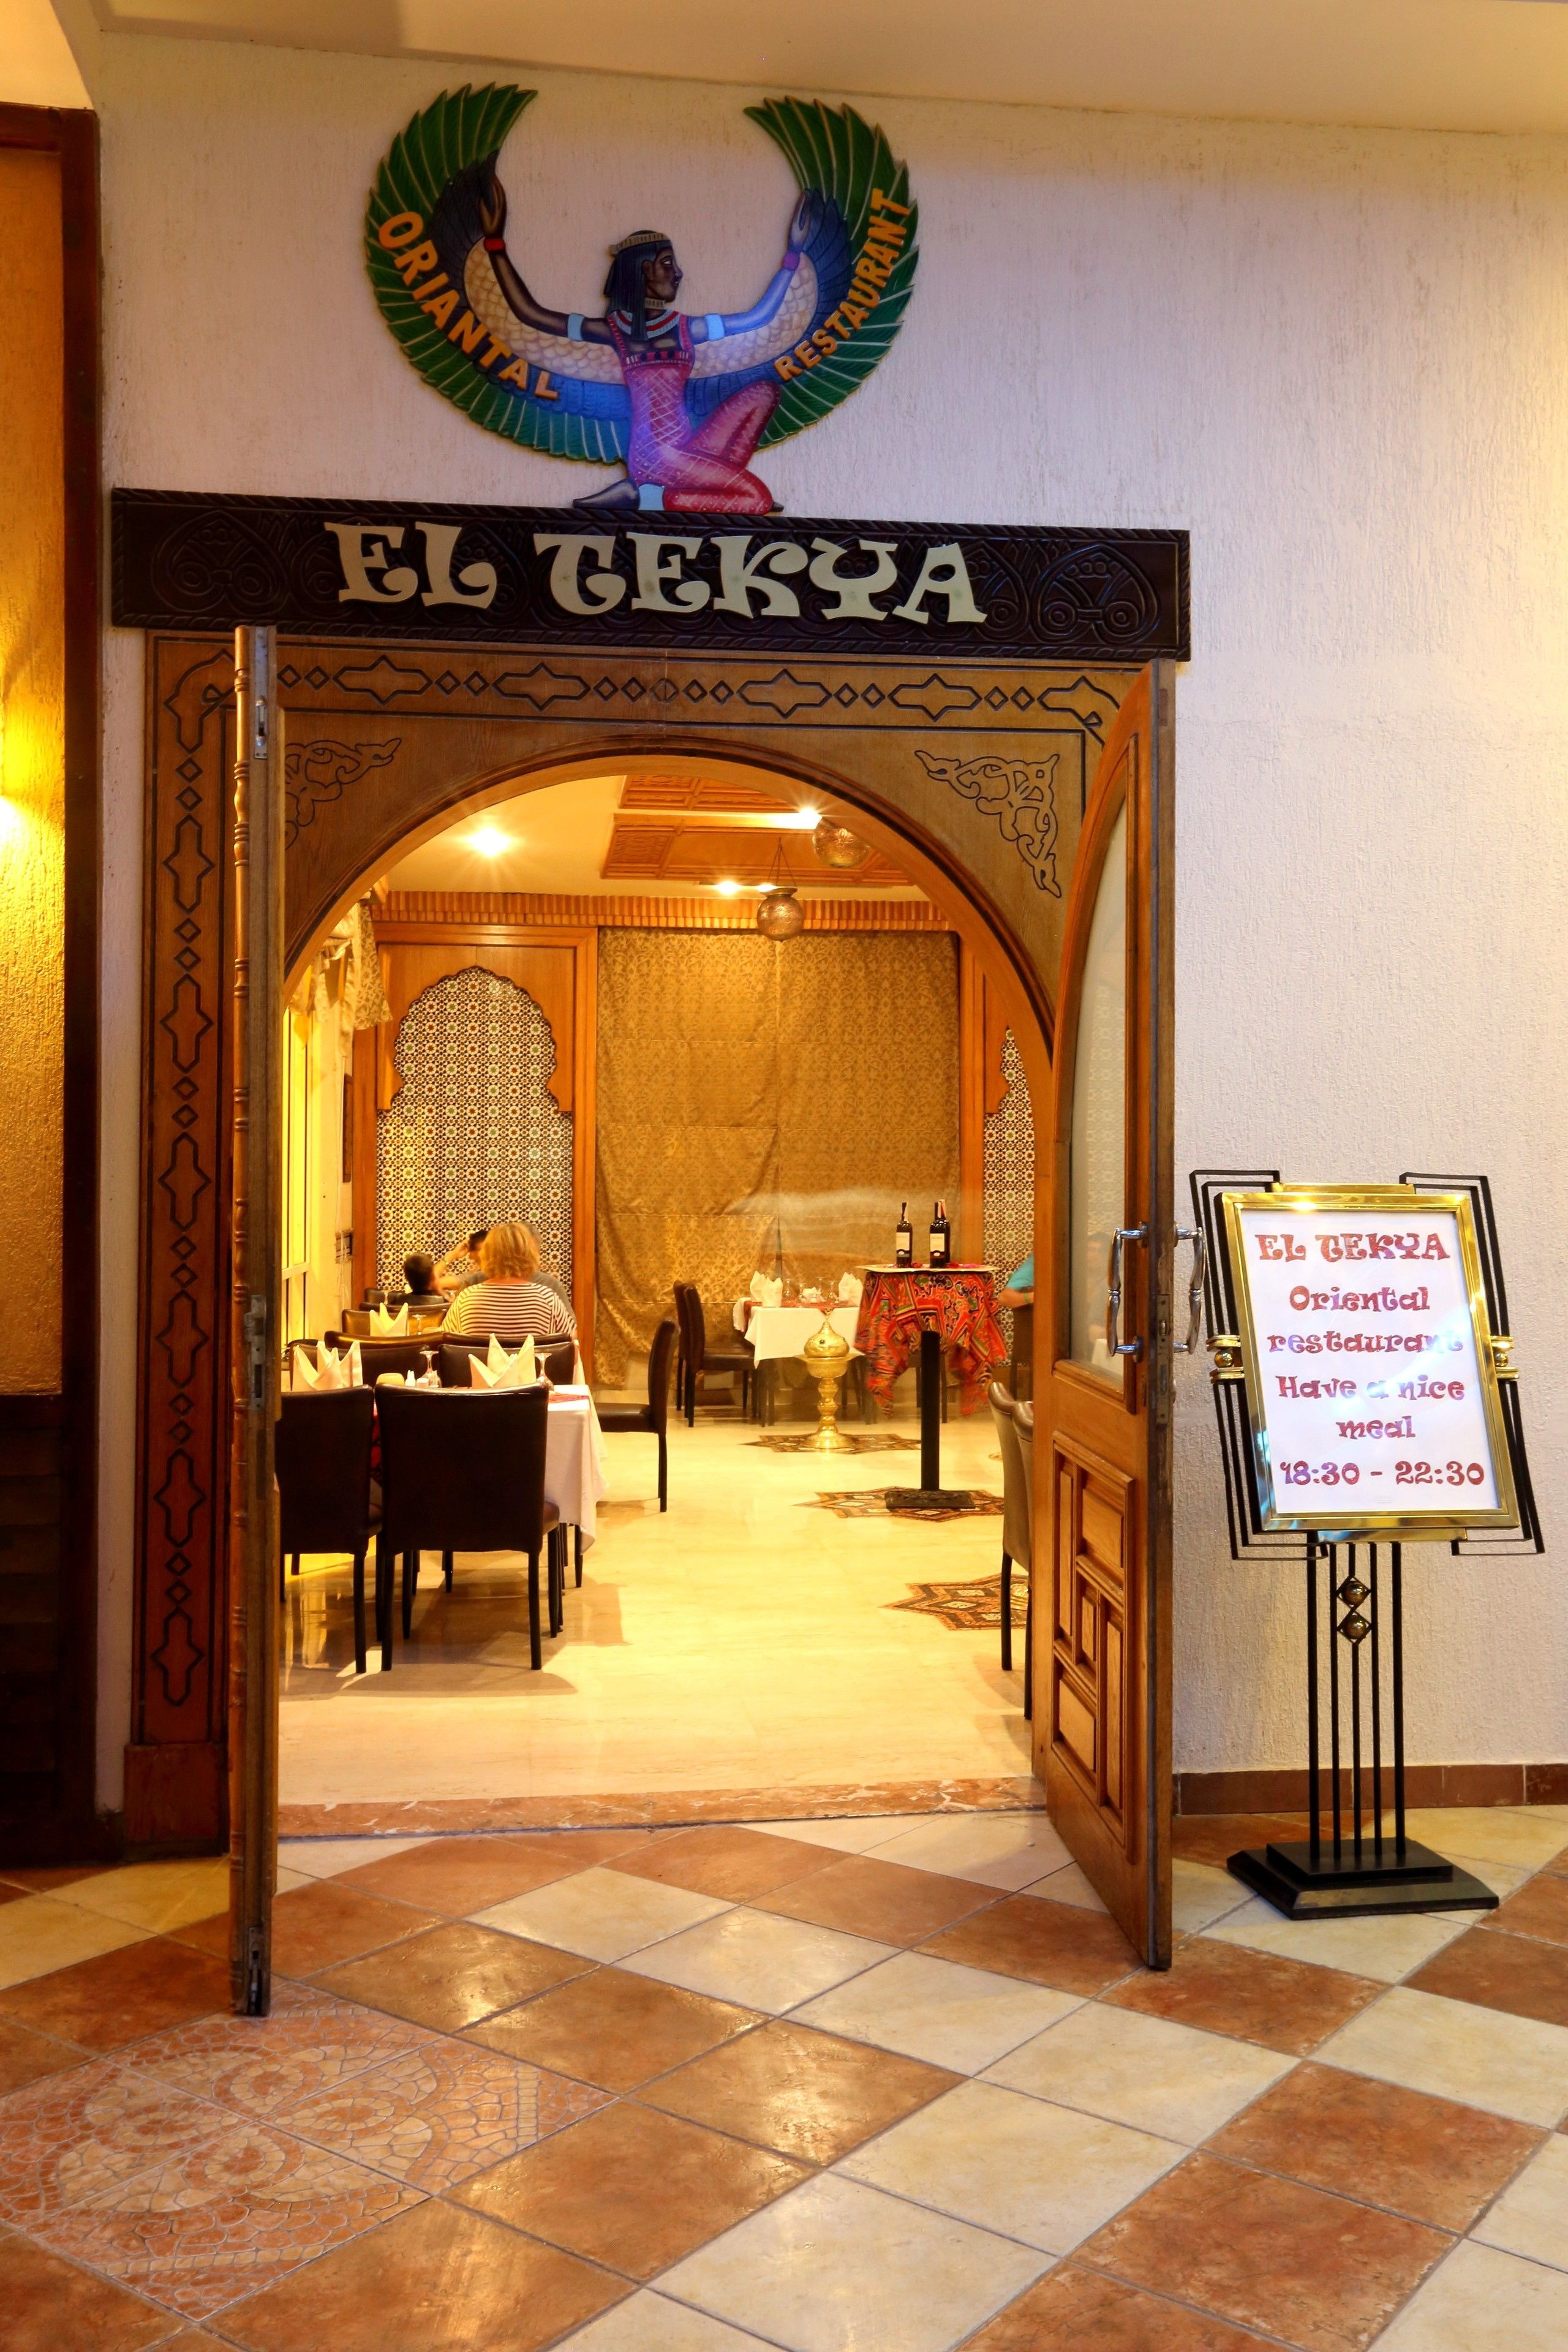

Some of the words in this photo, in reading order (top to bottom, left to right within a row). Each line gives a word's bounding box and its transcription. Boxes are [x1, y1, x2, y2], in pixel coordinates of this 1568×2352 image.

[379, 212, 559, 400] ORIANTAL
[774, 188, 911, 381] RESTAURANT
[324, 521, 497, 609] EL
[533, 531, 987, 625] TEKYA
[1255, 1234, 1306, 1262] EL
[1315, 1233, 1450, 1262] TEKYA
[1289, 1286, 1430, 1311] Oriental
[1276, 1376, 1357, 1399] Have
[1398, 1374, 1464, 1401] nice
[1336, 1415, 1415, 1439] meal
[1280, 1460, 1360, 1485] 18:30
[1395, 1461, 1485, 1486] 22:30
